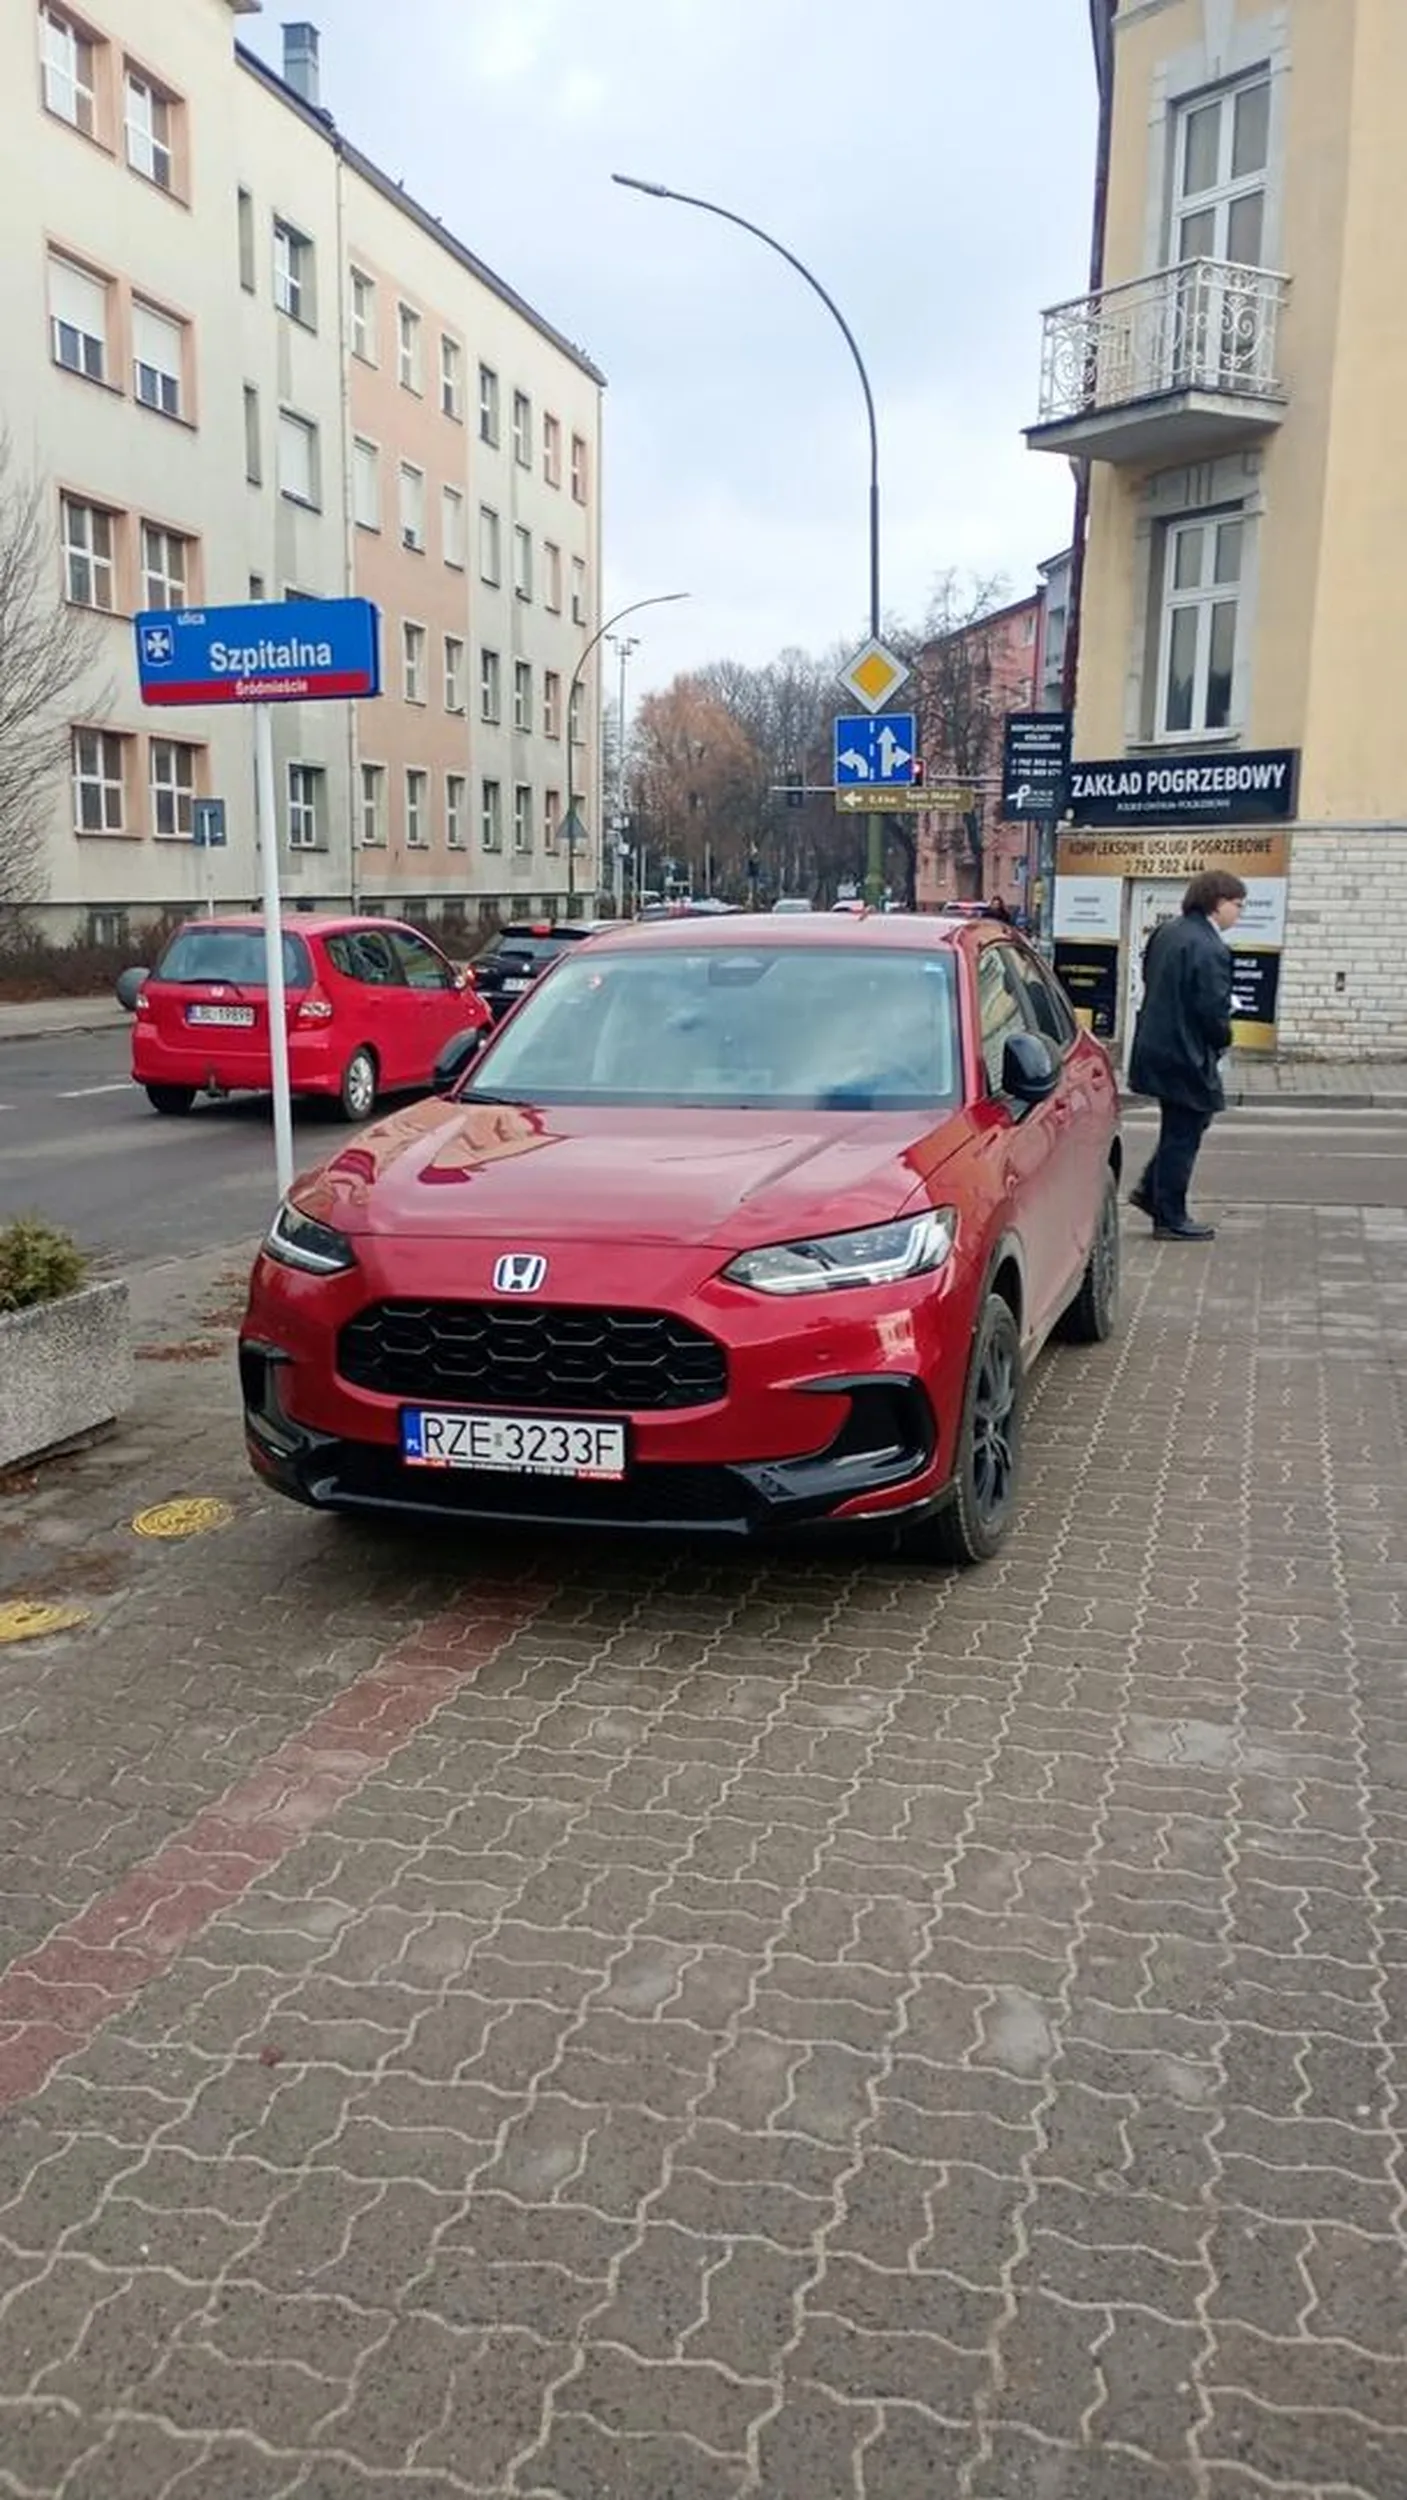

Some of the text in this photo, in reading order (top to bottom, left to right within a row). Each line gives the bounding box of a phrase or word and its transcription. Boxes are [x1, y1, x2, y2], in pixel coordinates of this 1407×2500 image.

[177, 613, 206, 626] ulica
[209, 637, 332, 676] Szpitalna
[234, 679, 309, 696] Śródmieście
[1071, 763, 1286, 798] ZAKŁAD POGRZEBOWY
[1069, 837, 1272, 856] KOMPLEKSOWE USŁUGI POGRZEBOWE
[423, 1417, 619, 1466] RZE 3233F
